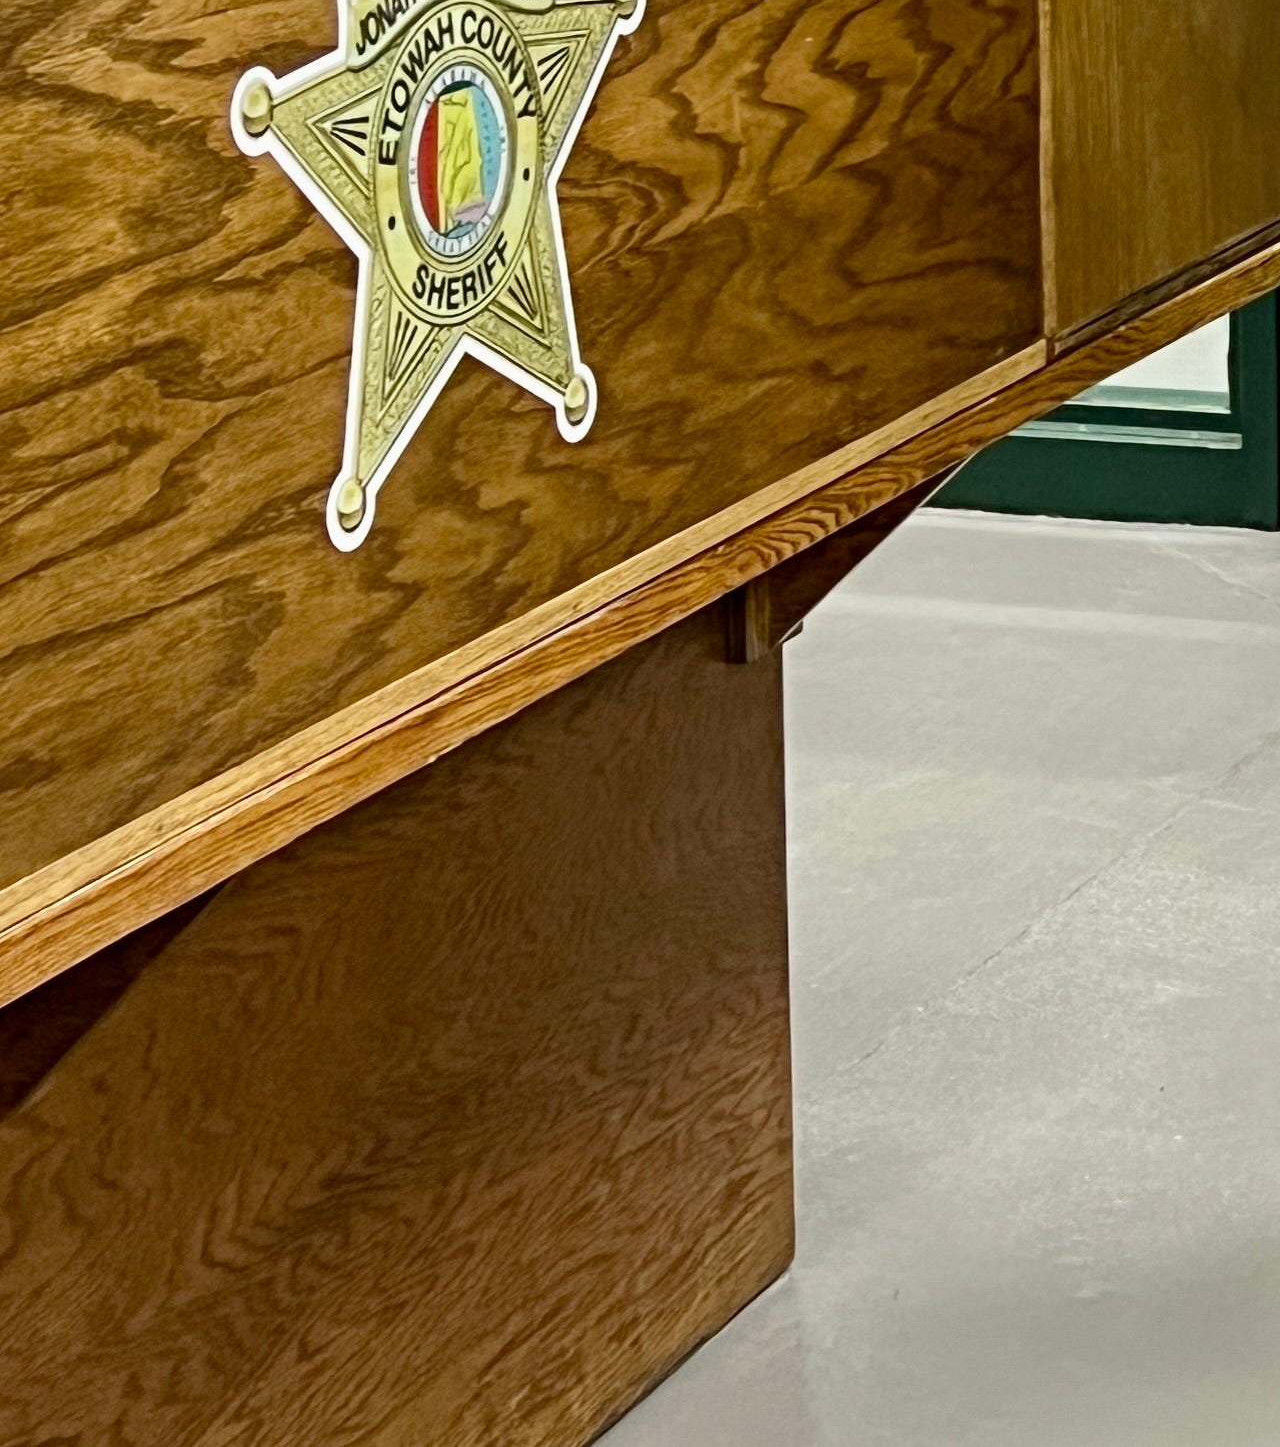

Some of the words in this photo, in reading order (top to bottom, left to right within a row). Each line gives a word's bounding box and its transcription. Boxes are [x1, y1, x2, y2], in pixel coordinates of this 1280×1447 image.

[378, 12, 455, 166] ETOWAH
[461, 9, 537, 118] COUNTY
[412, 230, 508, 310] SHERIFF
